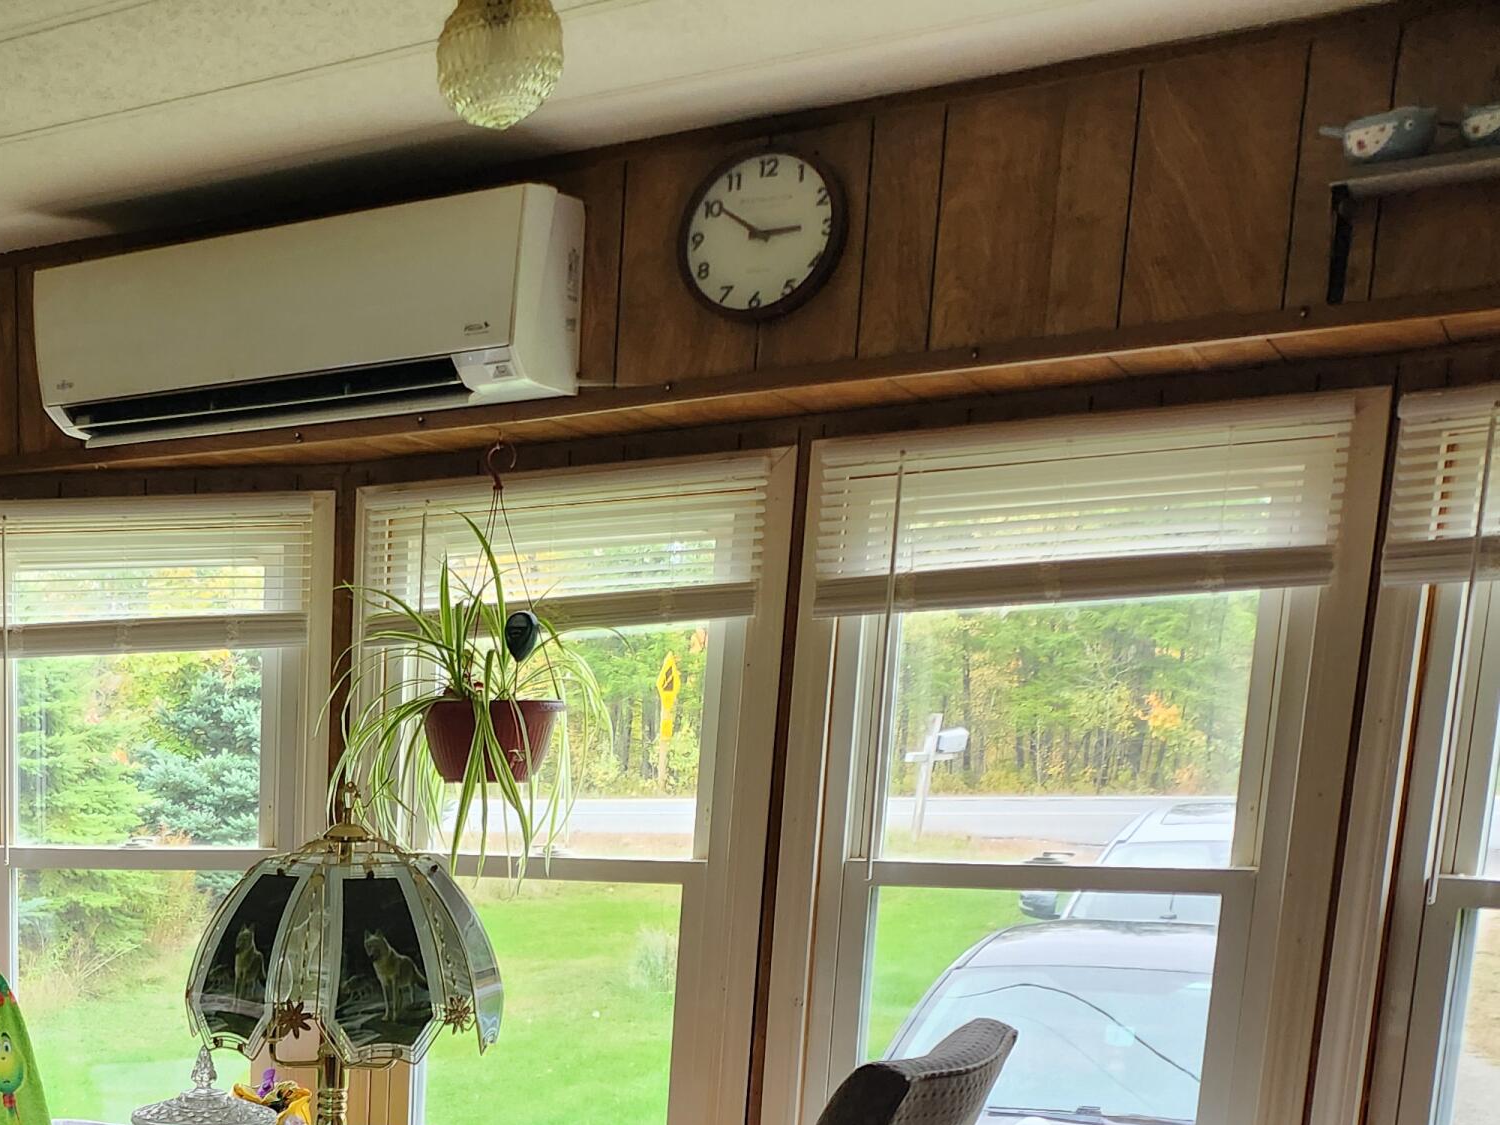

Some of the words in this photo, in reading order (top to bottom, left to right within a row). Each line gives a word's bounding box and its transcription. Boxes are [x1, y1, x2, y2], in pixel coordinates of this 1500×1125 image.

[758, 157, 779, 178] 12
[797, 164, 805, 183] 1
[726, 173, 742, 192] 11
[816, 187, 829, 206] 2
[704, 200, 723, 219] 10
[821, 218, 831, 236] 3
[691, 233, 704, 251] 9
[698, 262, 709, 279] 8
[719, 285, 734, 303] 7
[780, 277, 796, 296] 5
[748, 291, 761, 308] 6
